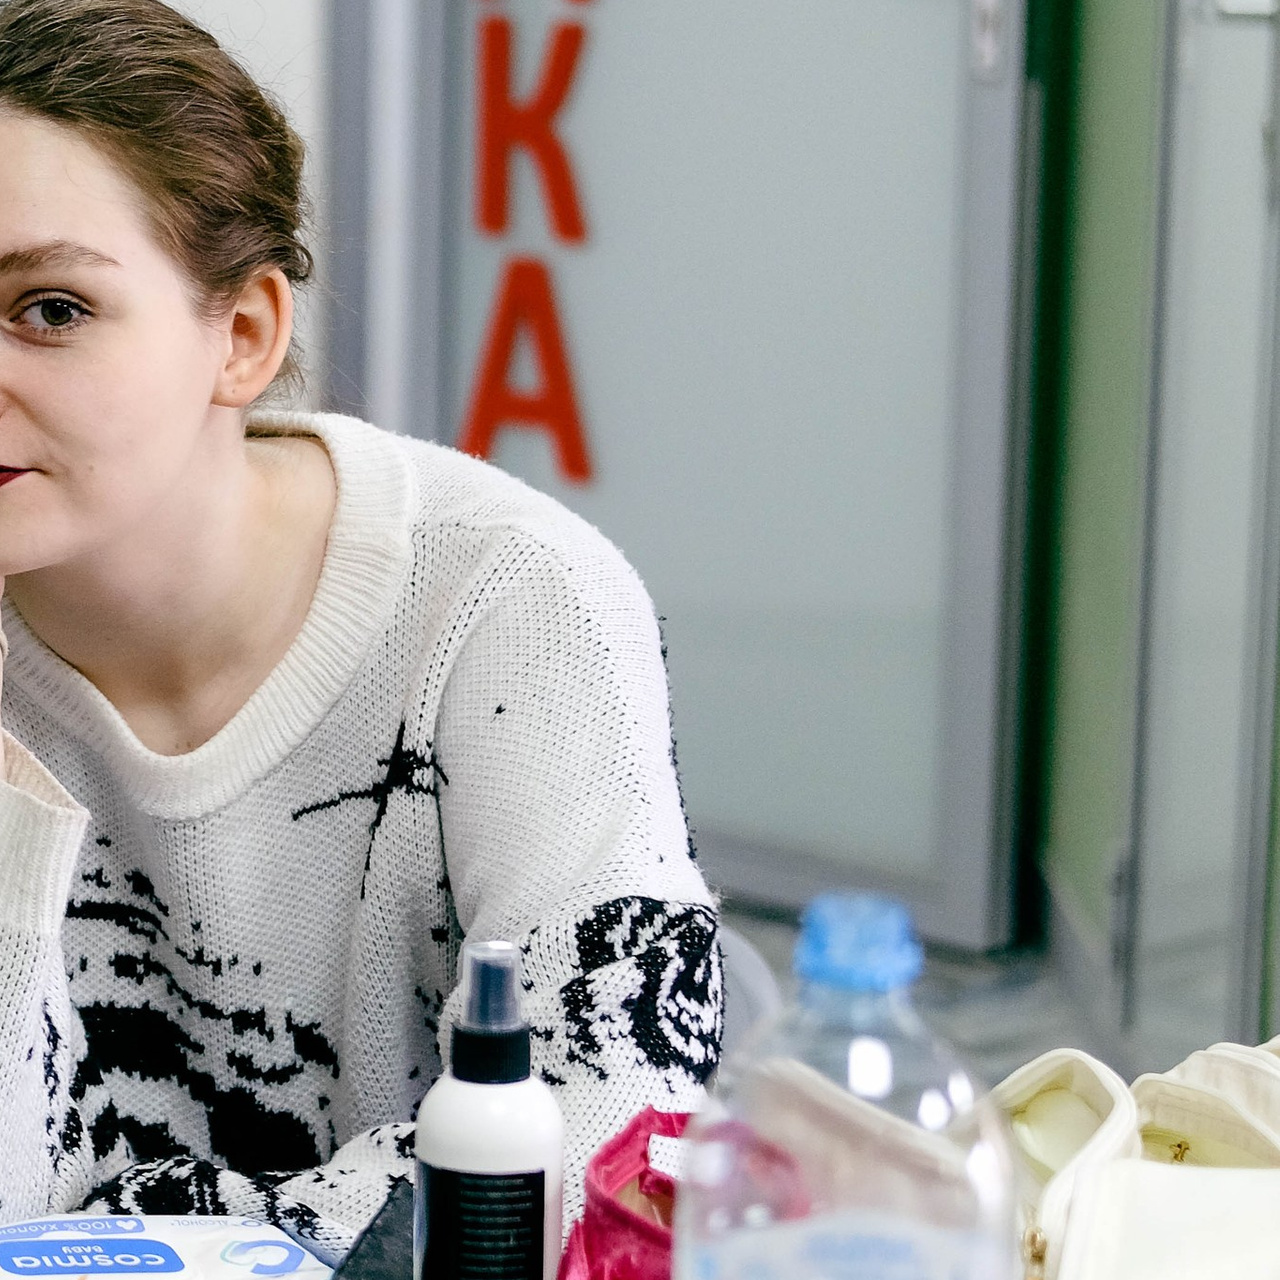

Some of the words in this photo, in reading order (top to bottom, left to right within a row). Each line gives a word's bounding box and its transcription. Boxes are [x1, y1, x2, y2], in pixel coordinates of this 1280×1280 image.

[64, 1221, 113, 1232] 100%
[61, 1245, 104, 1255] BABY
[11, 1253, 166, 1269] cosmia
